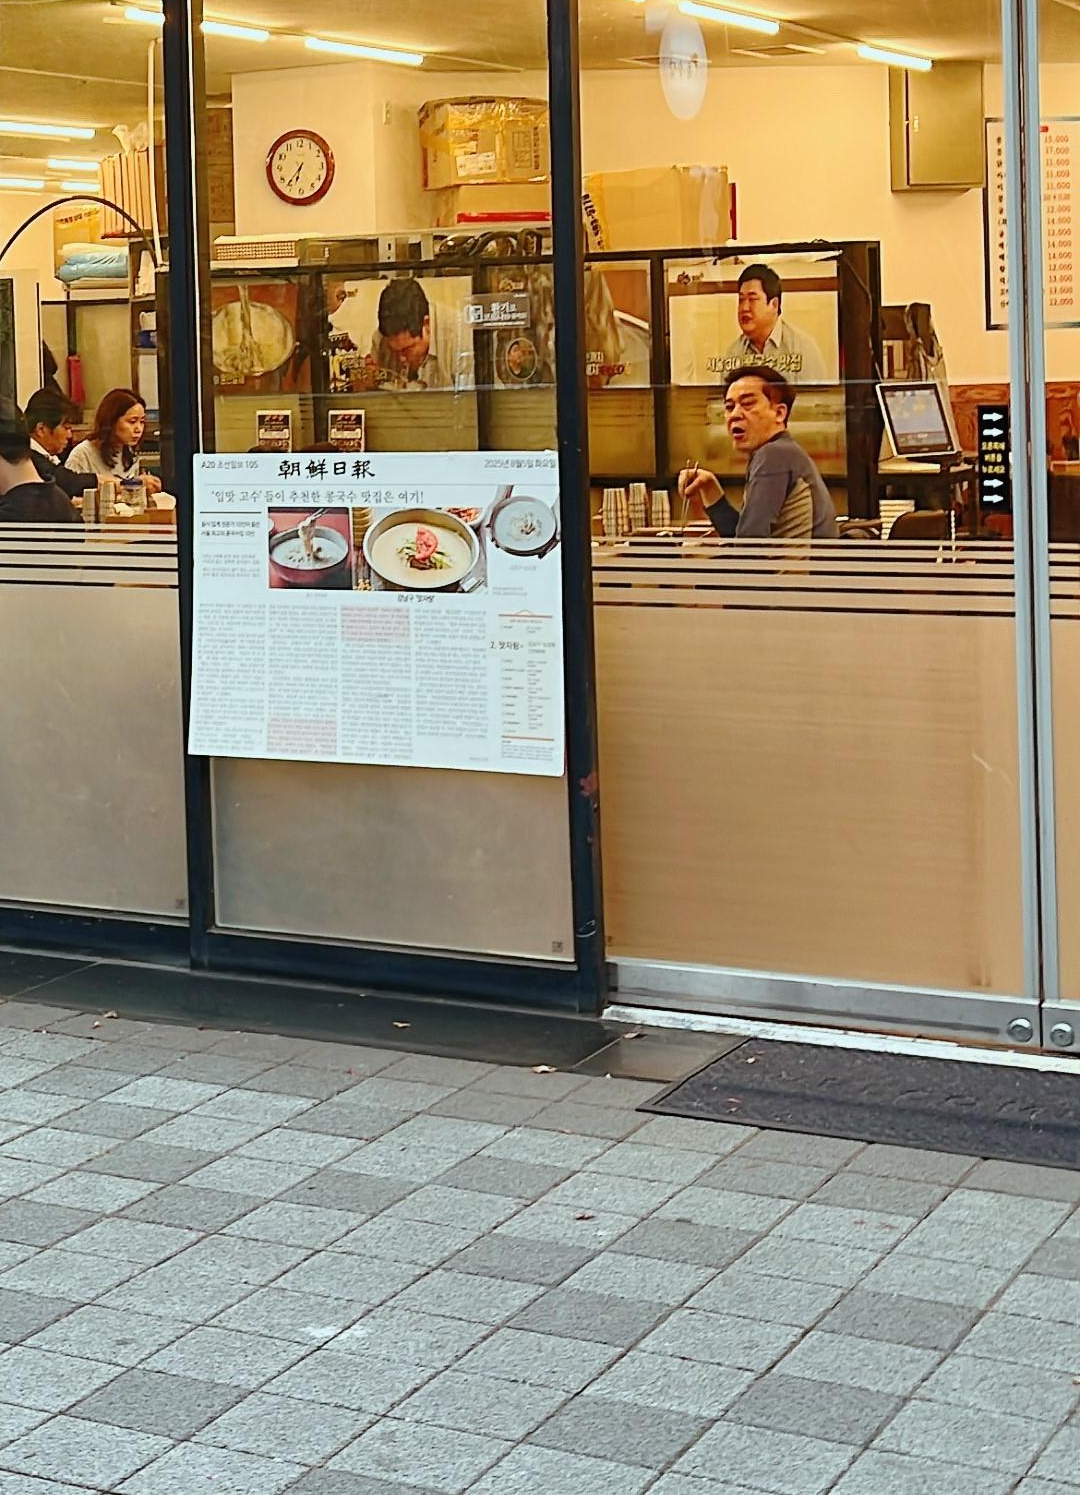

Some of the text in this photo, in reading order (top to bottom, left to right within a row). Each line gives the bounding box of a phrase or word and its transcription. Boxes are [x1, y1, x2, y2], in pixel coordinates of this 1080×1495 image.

[780, 353, 803, 373] 맛집
[277, 458, 376, 480] 朝鮮日報
[289, 490, 321, 503] 추천한
[325, 490, 358, 503] 콩국수
[361, 490, 394, 503] 맛집은
[398, 490, 424, 504] 여기!
